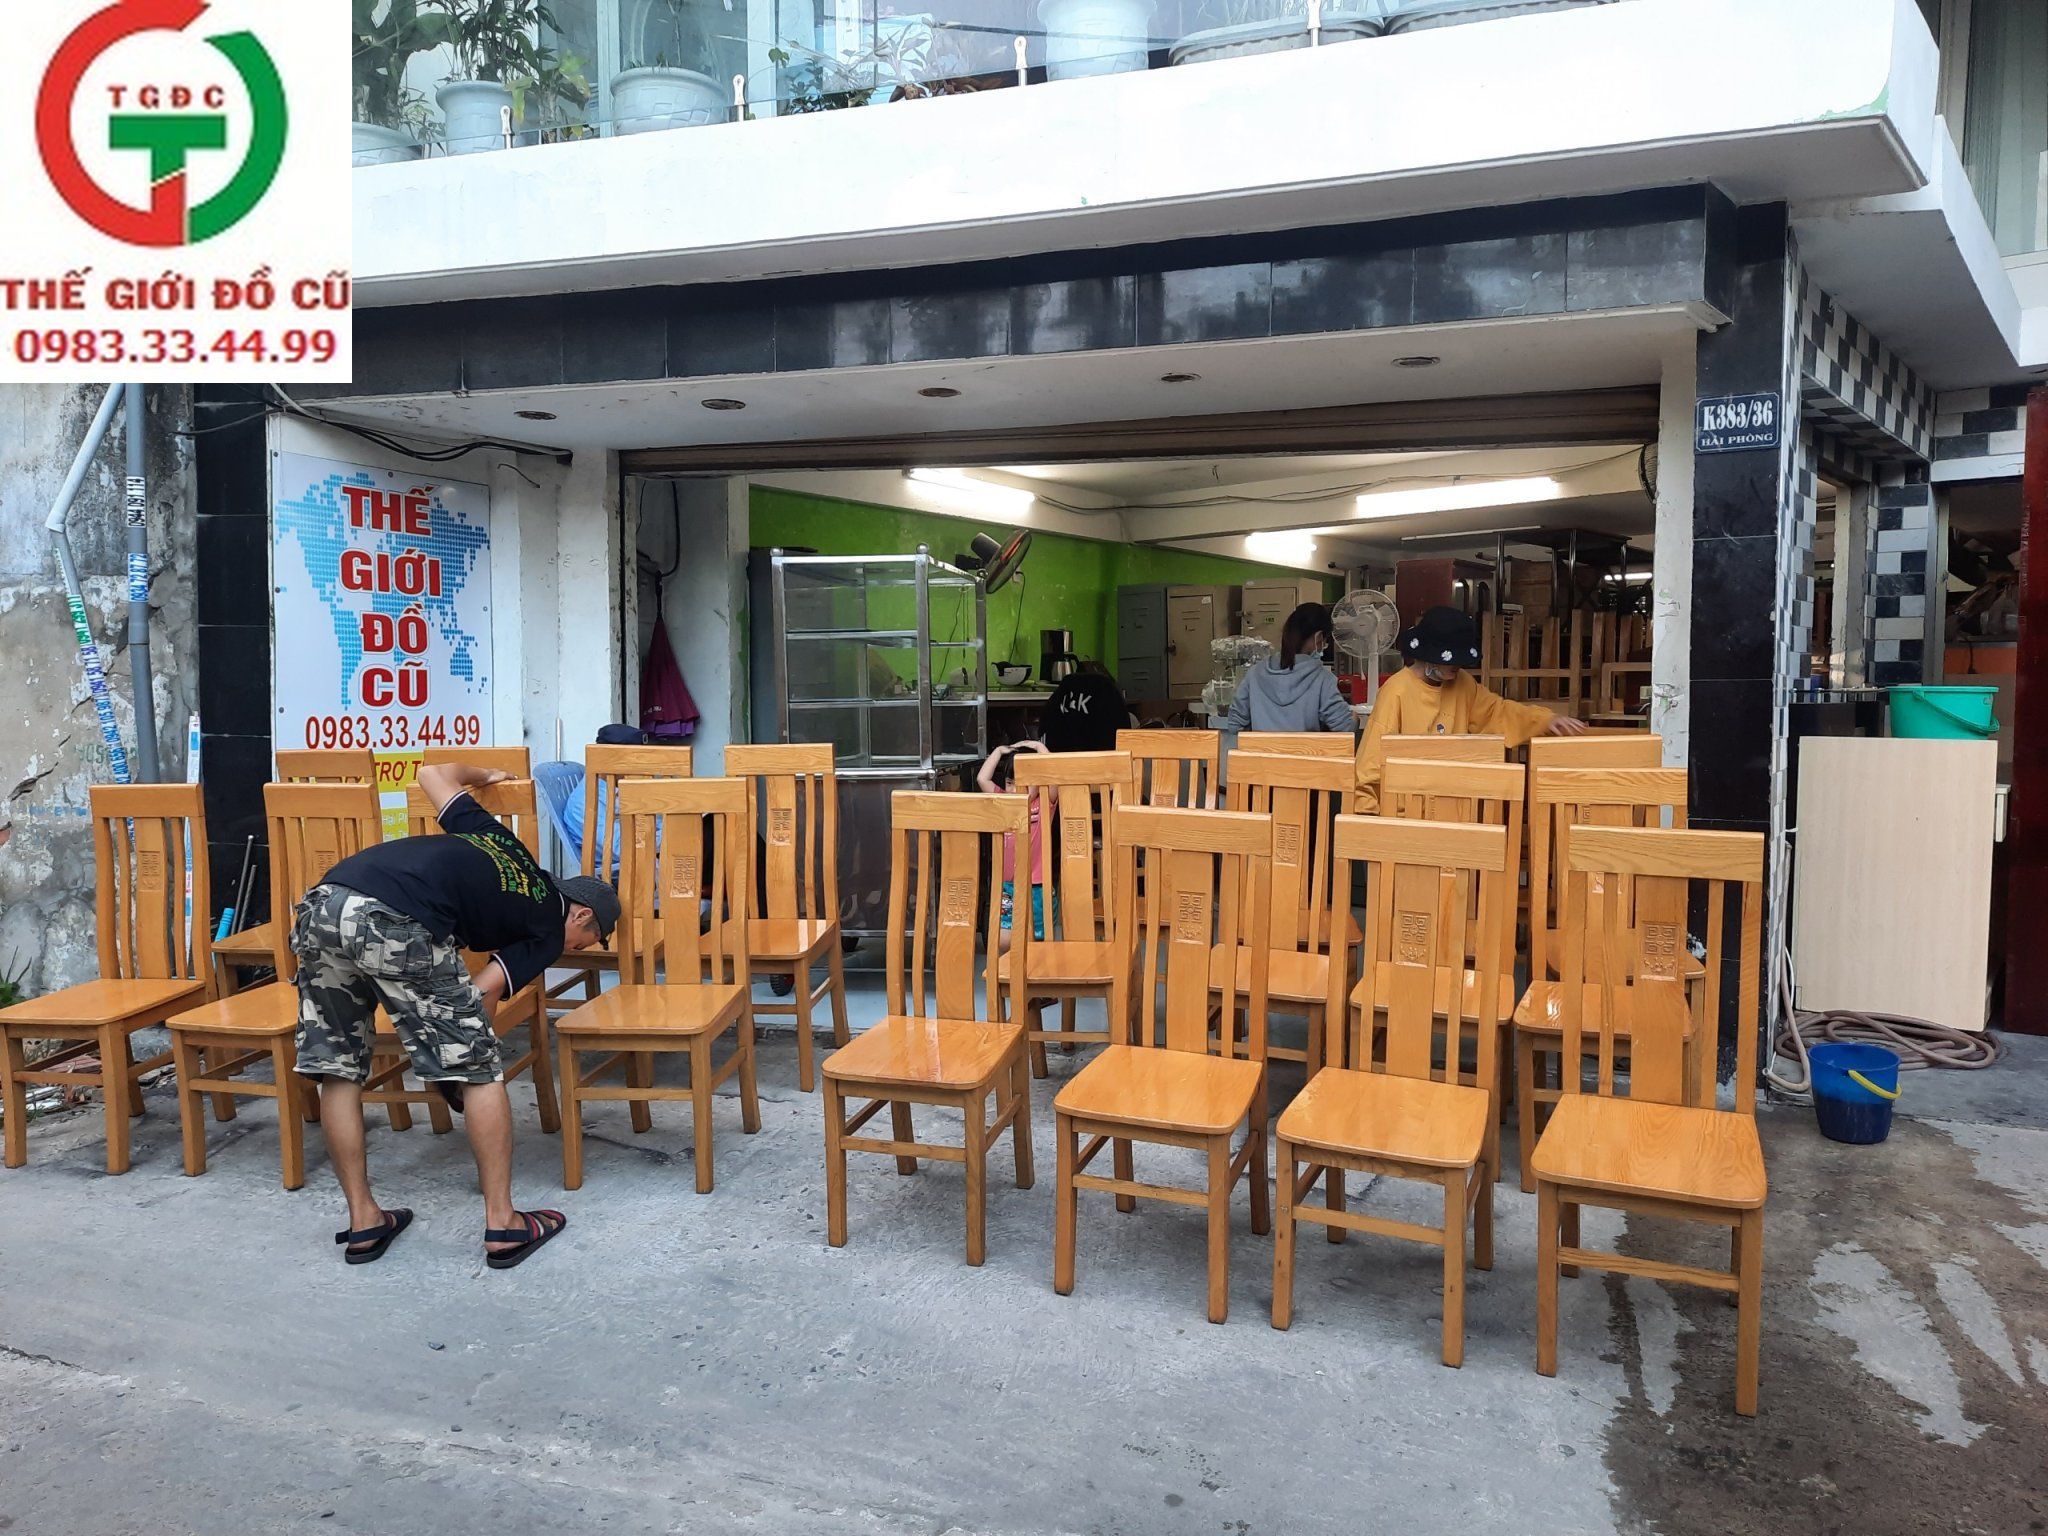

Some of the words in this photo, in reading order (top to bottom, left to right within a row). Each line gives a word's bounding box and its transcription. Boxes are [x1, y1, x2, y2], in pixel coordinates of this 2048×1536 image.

[1703, 400, 1773, 431] K383/36
[1728, 432, 1773, 445] PHÒNG
[342, 484, 436, 536] THẾ
[339, 549, 441, 597] GIỚI
[361, 603, 429, 654] ĐỒ
[362, 660, 429, 707] CŨ
[306, 715, 480, 749] 0983.33.44.99
